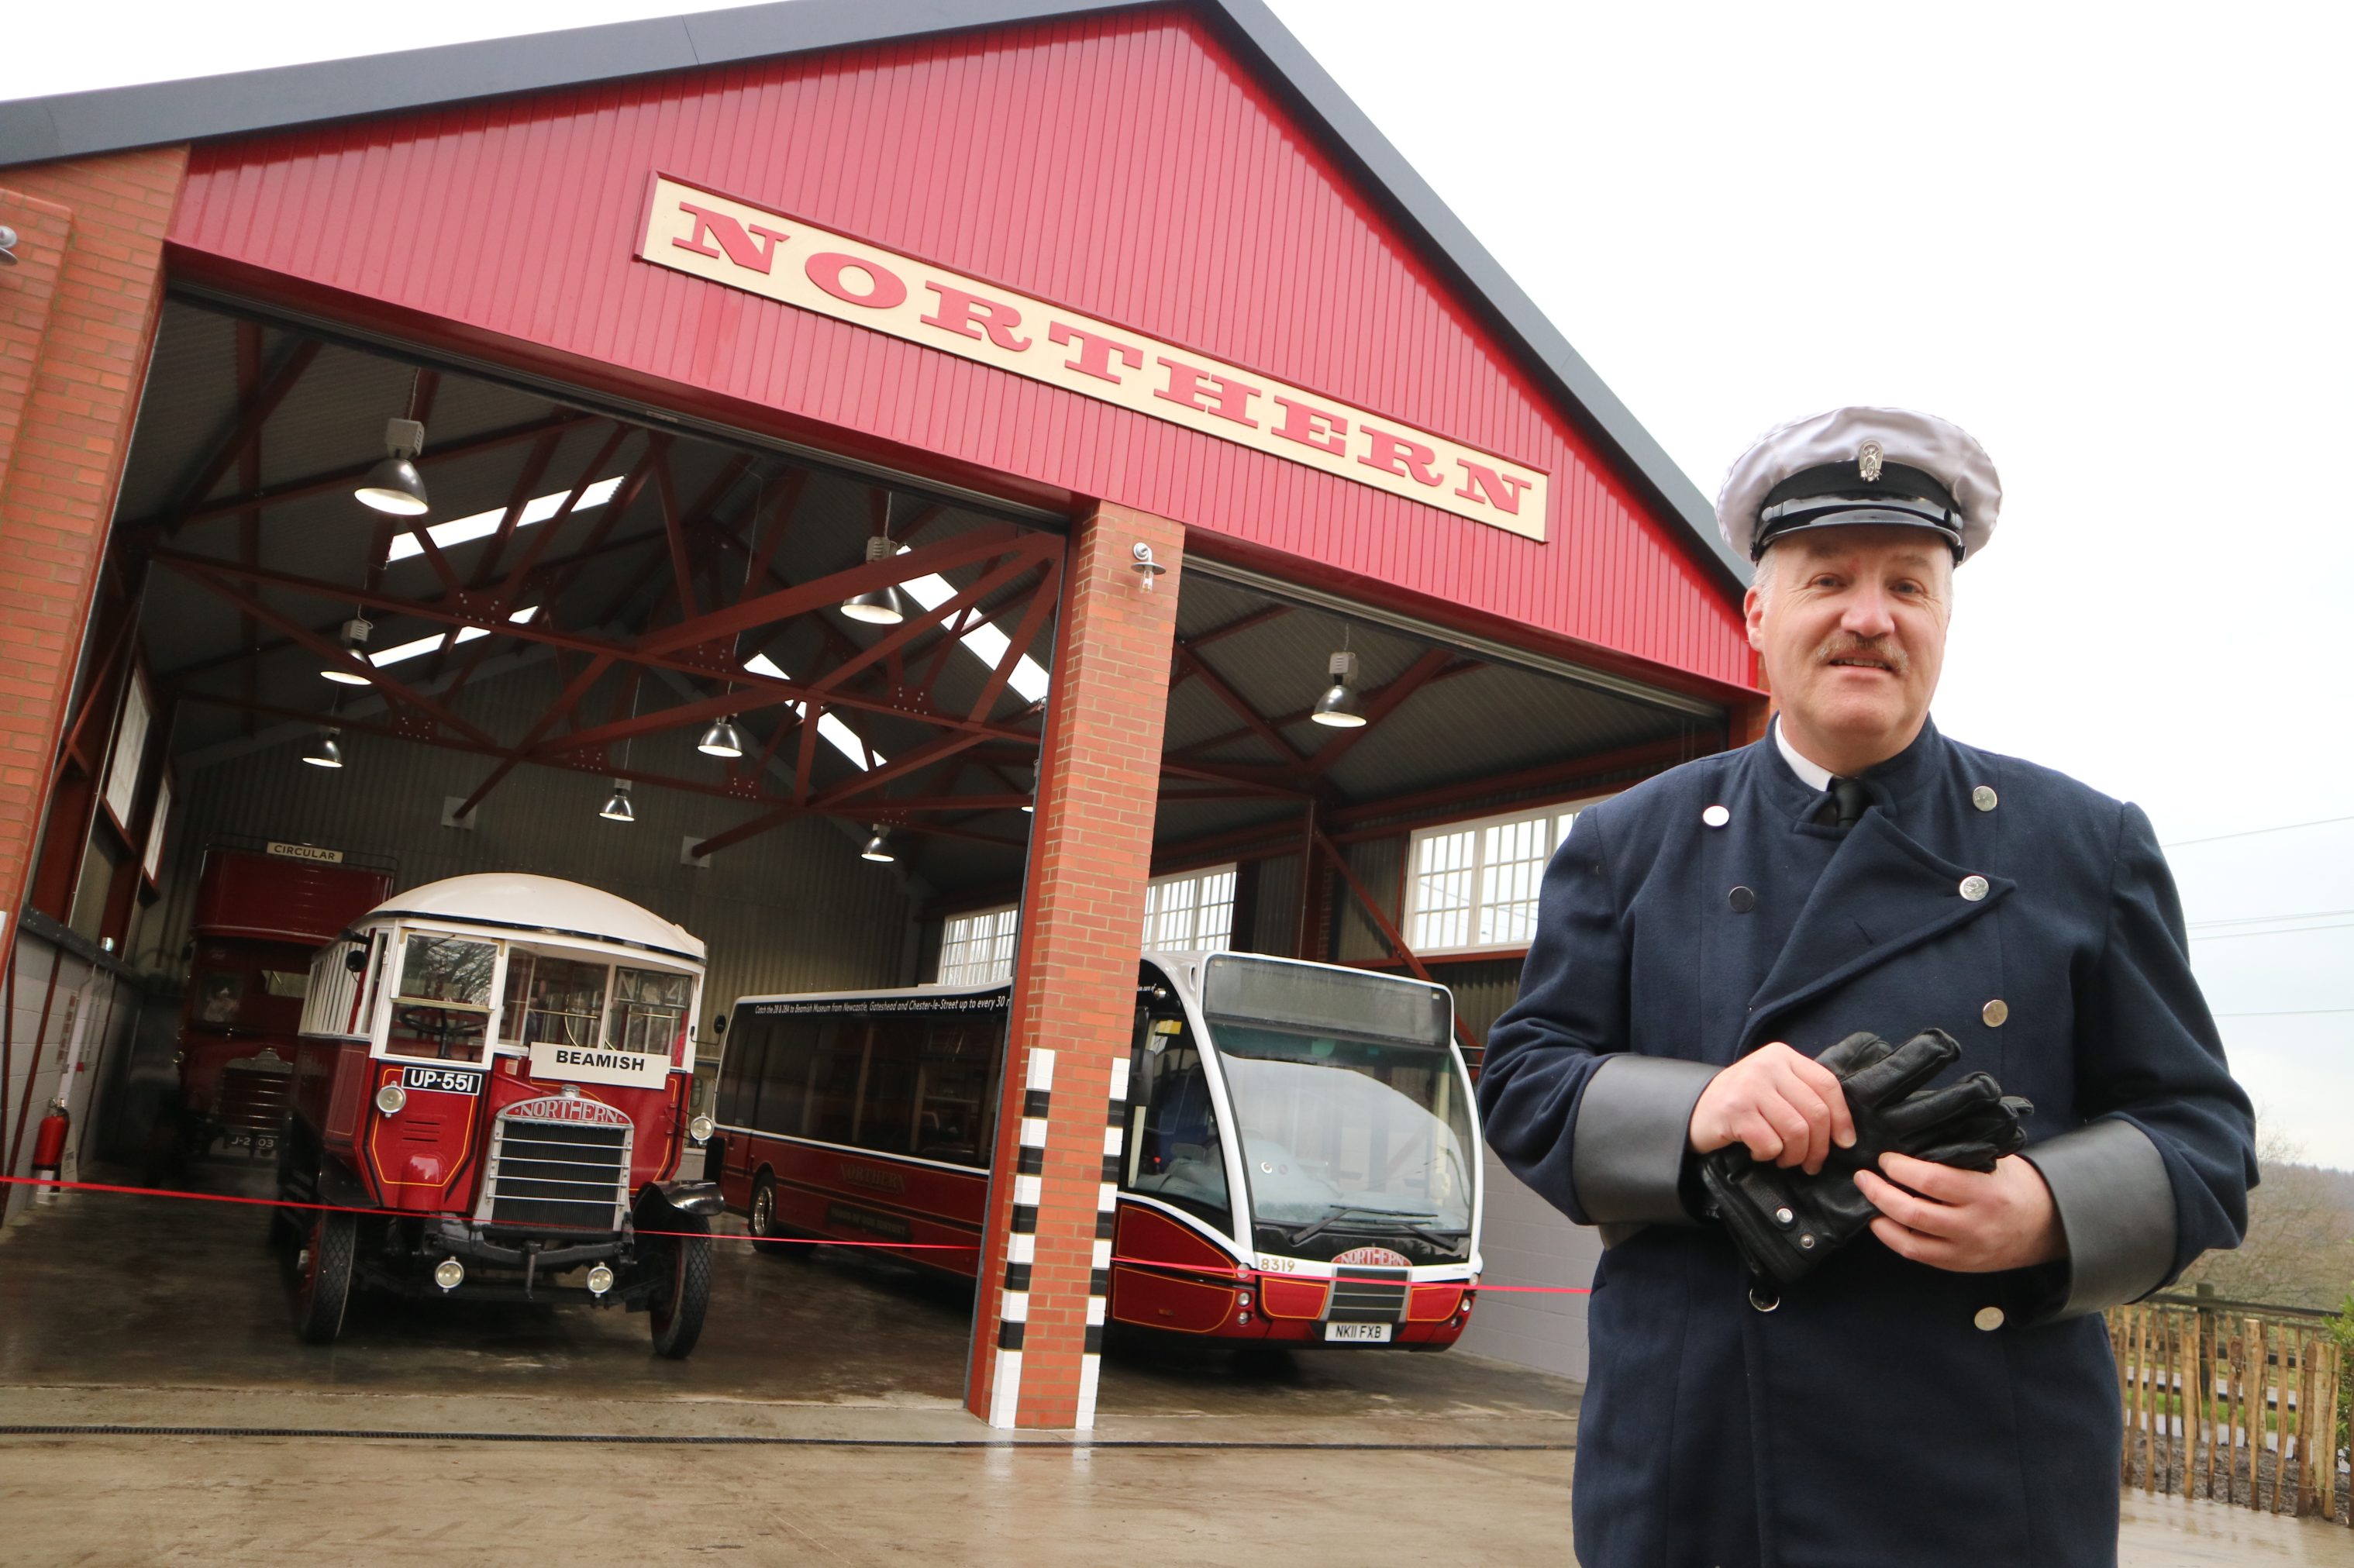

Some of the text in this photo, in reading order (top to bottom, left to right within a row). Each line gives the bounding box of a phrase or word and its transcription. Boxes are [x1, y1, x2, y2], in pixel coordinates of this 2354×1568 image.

[672, 202, 1532, 515] NORTHERN
[274, 845, 335, 860] CIRCULAR
[794, 1004, 813, 1013] Beamish
[813, 1003, 831, 1012] Museum
[831, 1002, 843, 1012] from
[869, 1001, 897, 1011] Gateshead
[897, 1001, 909, 1011] and
[908, 998, 958, 1011] Chester-le-Street
[959, 999, 968, 1012] up
[969, 998, 977, 1008] to
[977, 999, 995, 1011] every
[995, 995, 1006, 1008] 30
[556, 1049, 645, 1071] BEAMISH
[410, 1069, 474, 1093] UP-551
[520, 1099, 619, 1123] NORTHERN
[231, 1136, 274, 1148] J-203
[839, 1163, 907, 1195] NORTHERN
[1260, 1257, 1295, 1273] 8319
[1340, 1249, 1404, 1266] NORTHERN
[1336, 1325, 1382, 1339] NK11 FXB
